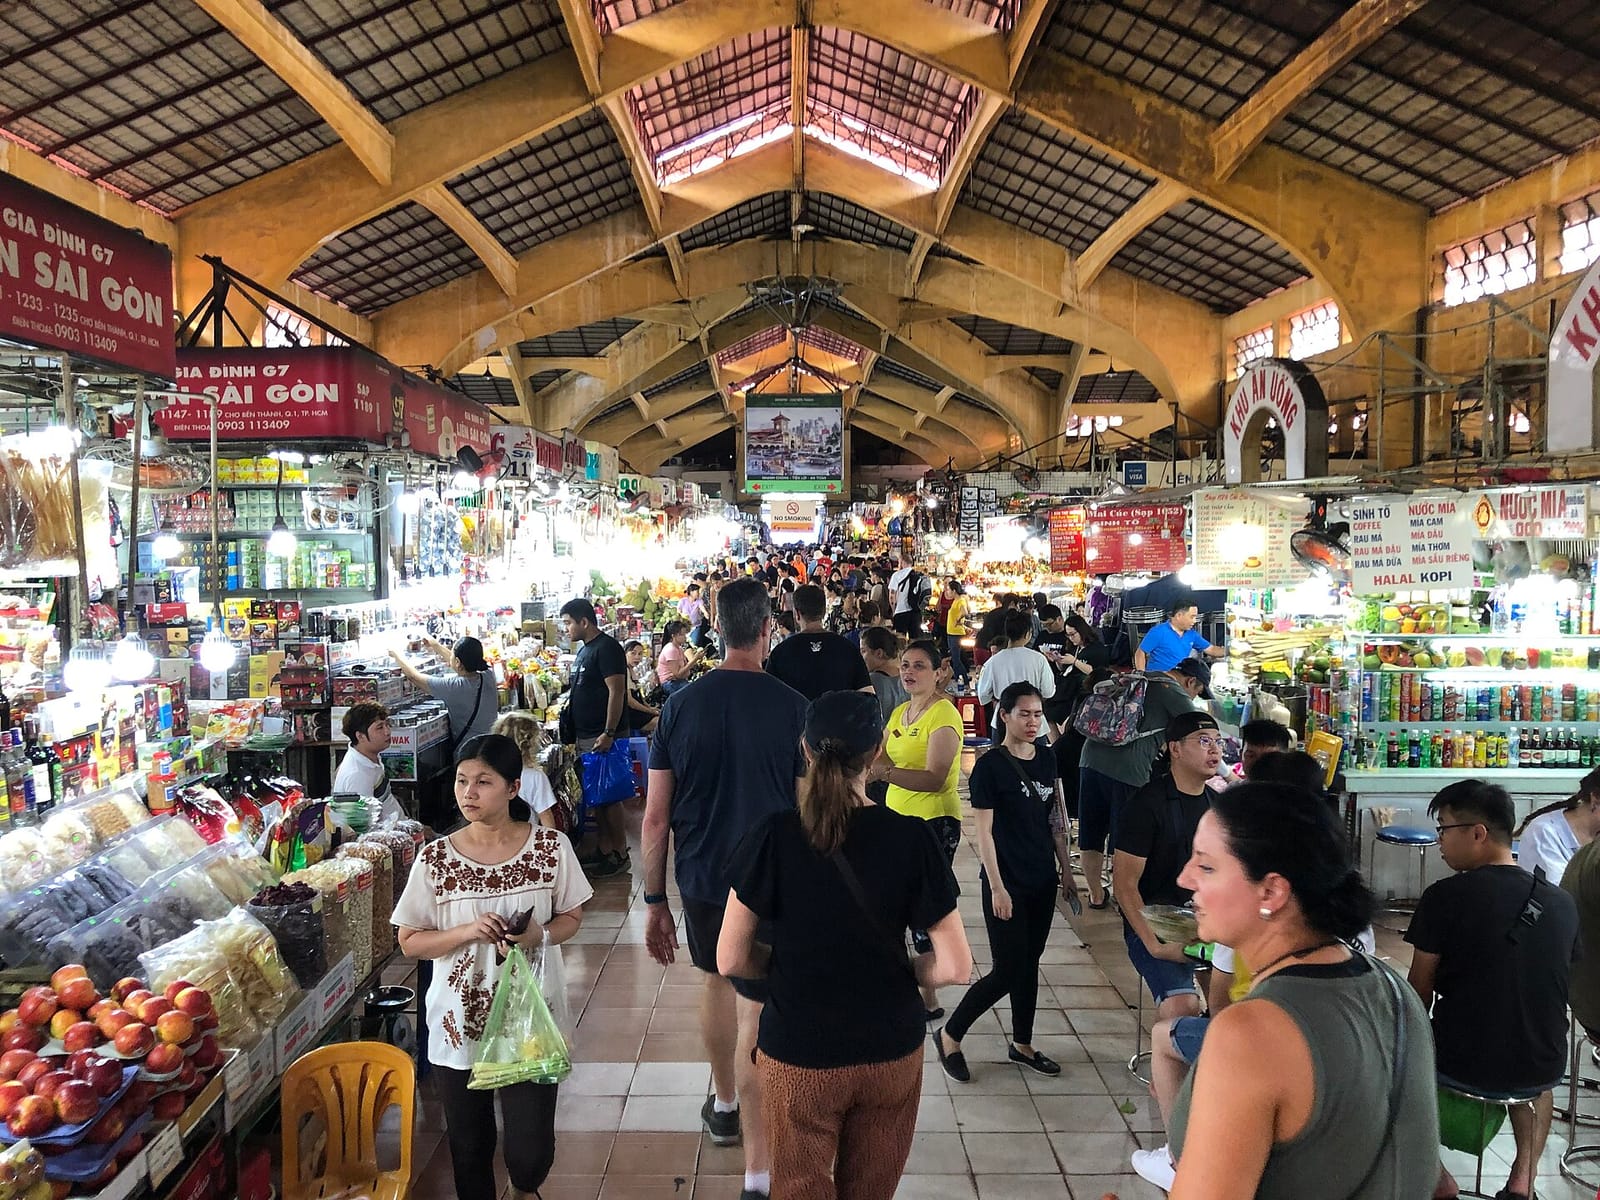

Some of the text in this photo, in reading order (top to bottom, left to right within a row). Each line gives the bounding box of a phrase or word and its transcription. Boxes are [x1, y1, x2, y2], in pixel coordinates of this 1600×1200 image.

[3, 207, 114, 266] GIA ĐÌNH G7
[34, 250, 88, 302] SÀI
[100, 277, 163, 328] GÒN
[16, 290, 43, 312] 1233
[54, 302, 79, 323] 1235
[54, 323, 81, 343] 0903
[83, 331, 118, 353] 113409
[209, 363, 256, 379] ĐÌNH
[262, 364, 290, 377] G7
[265, 379, 339, 404] GÒN
[1229, 386, 1249, 440] KHU
[217, 420, 245, 431] 0903
[250, 419, 290, 430] 113409
[1166, 471, 1193, 485] LÊN
[1109, 508, 1128, 517] Cúc
[1353, 508, 1375, 520] SINH
[1408, 501, 1456, 516] NƯỚC MÍA
[1353, 520, 1382, 531] COFFEE
[1410, 517, 1443, 527] MÍA CAM
[1354, 534, 1369, 544] RAU
[1411, 530, 1425, 540] MÍA
[1354, 547, 1369, 556] RAU
[1412, 541, 1450, 552] MÍA THƠM
[1355, 560, 1370, 569] RAU
[1412, 555, 1426, 565] MÍA
[1446, 553, 1470, 563] RIÊNG
[1373, 570, 1452, 586] HALAL KOPI
